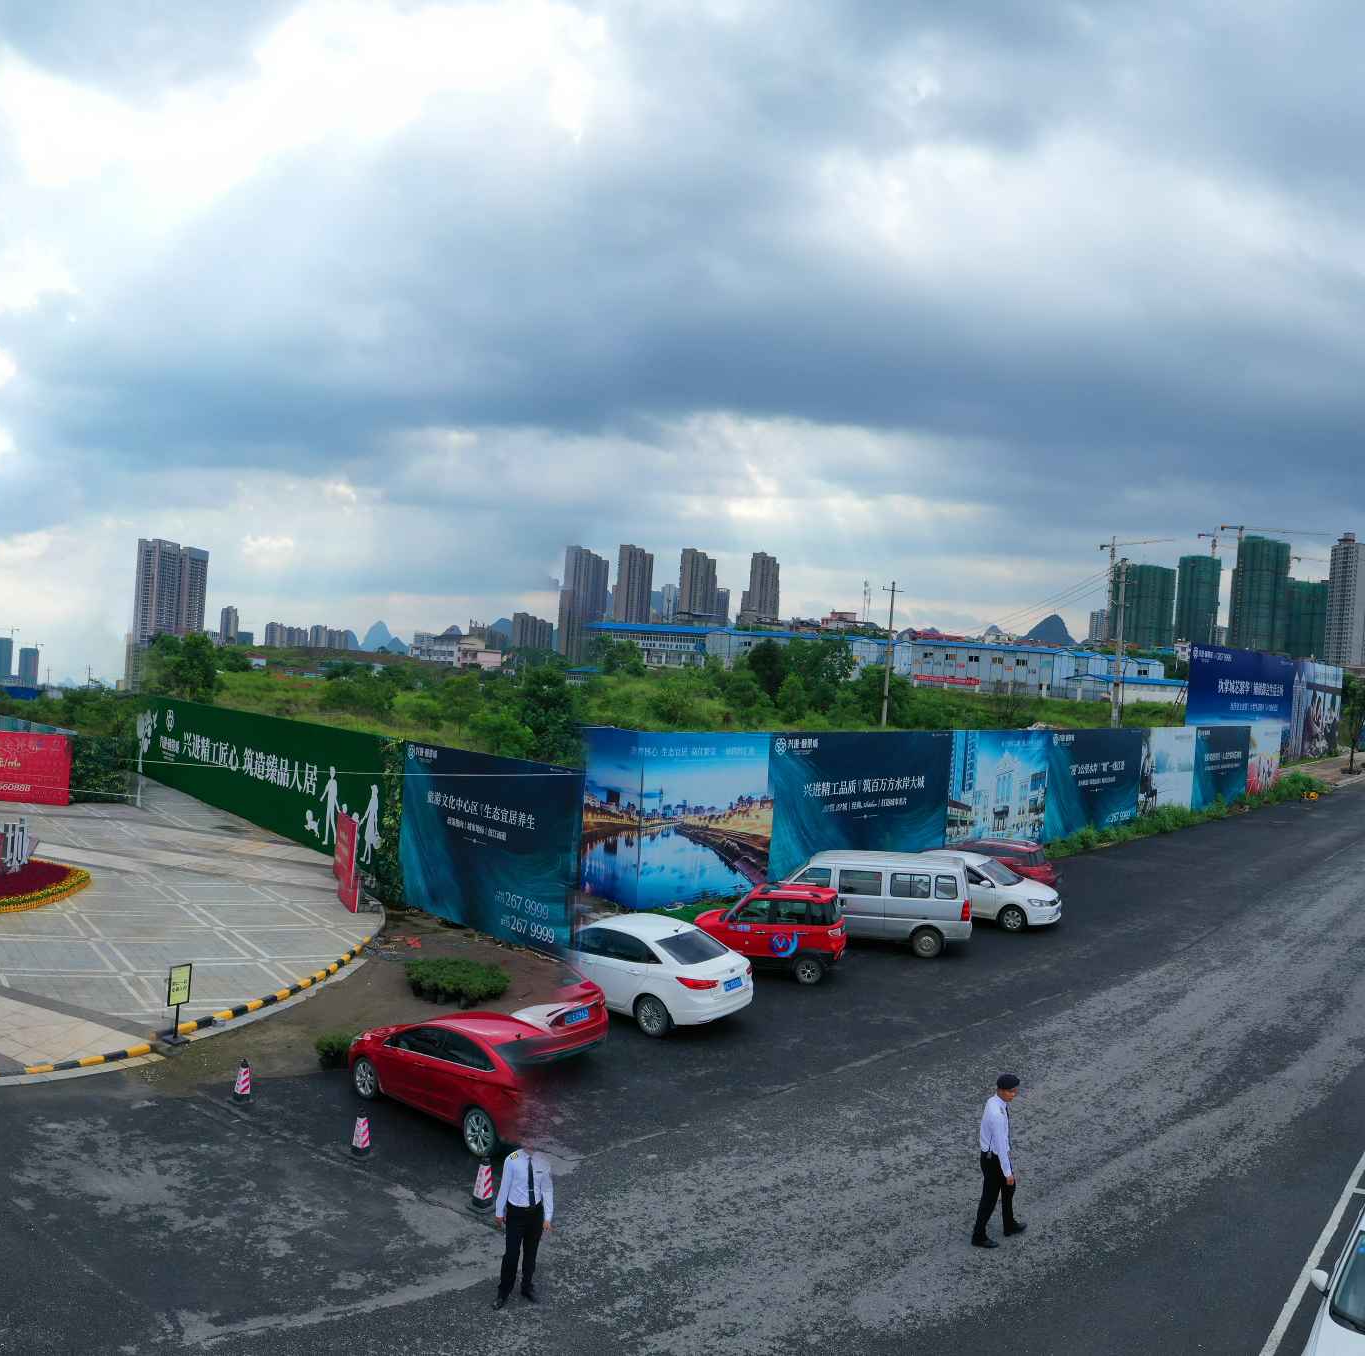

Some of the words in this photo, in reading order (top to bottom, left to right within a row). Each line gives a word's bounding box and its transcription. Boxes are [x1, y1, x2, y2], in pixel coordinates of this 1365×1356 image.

[183, 732, 239, 772] 兴进精工匠心
[243, 747, 318, 796] 筑造臻品人居
[803, 779, 857, 798] 兴进精工品质
[862, 775, 925, 793] 筑百万方水岸大城
[427, 790, 479, 816] 旅游文化中心区
[483, 805, 536, 831] 生态宜居养生
[505, 892, 522, 911] 267
[524, 899, 549, 921] 9999
[510, 916, 527, 936] 267
[530, 923, 555, 944] 9999
